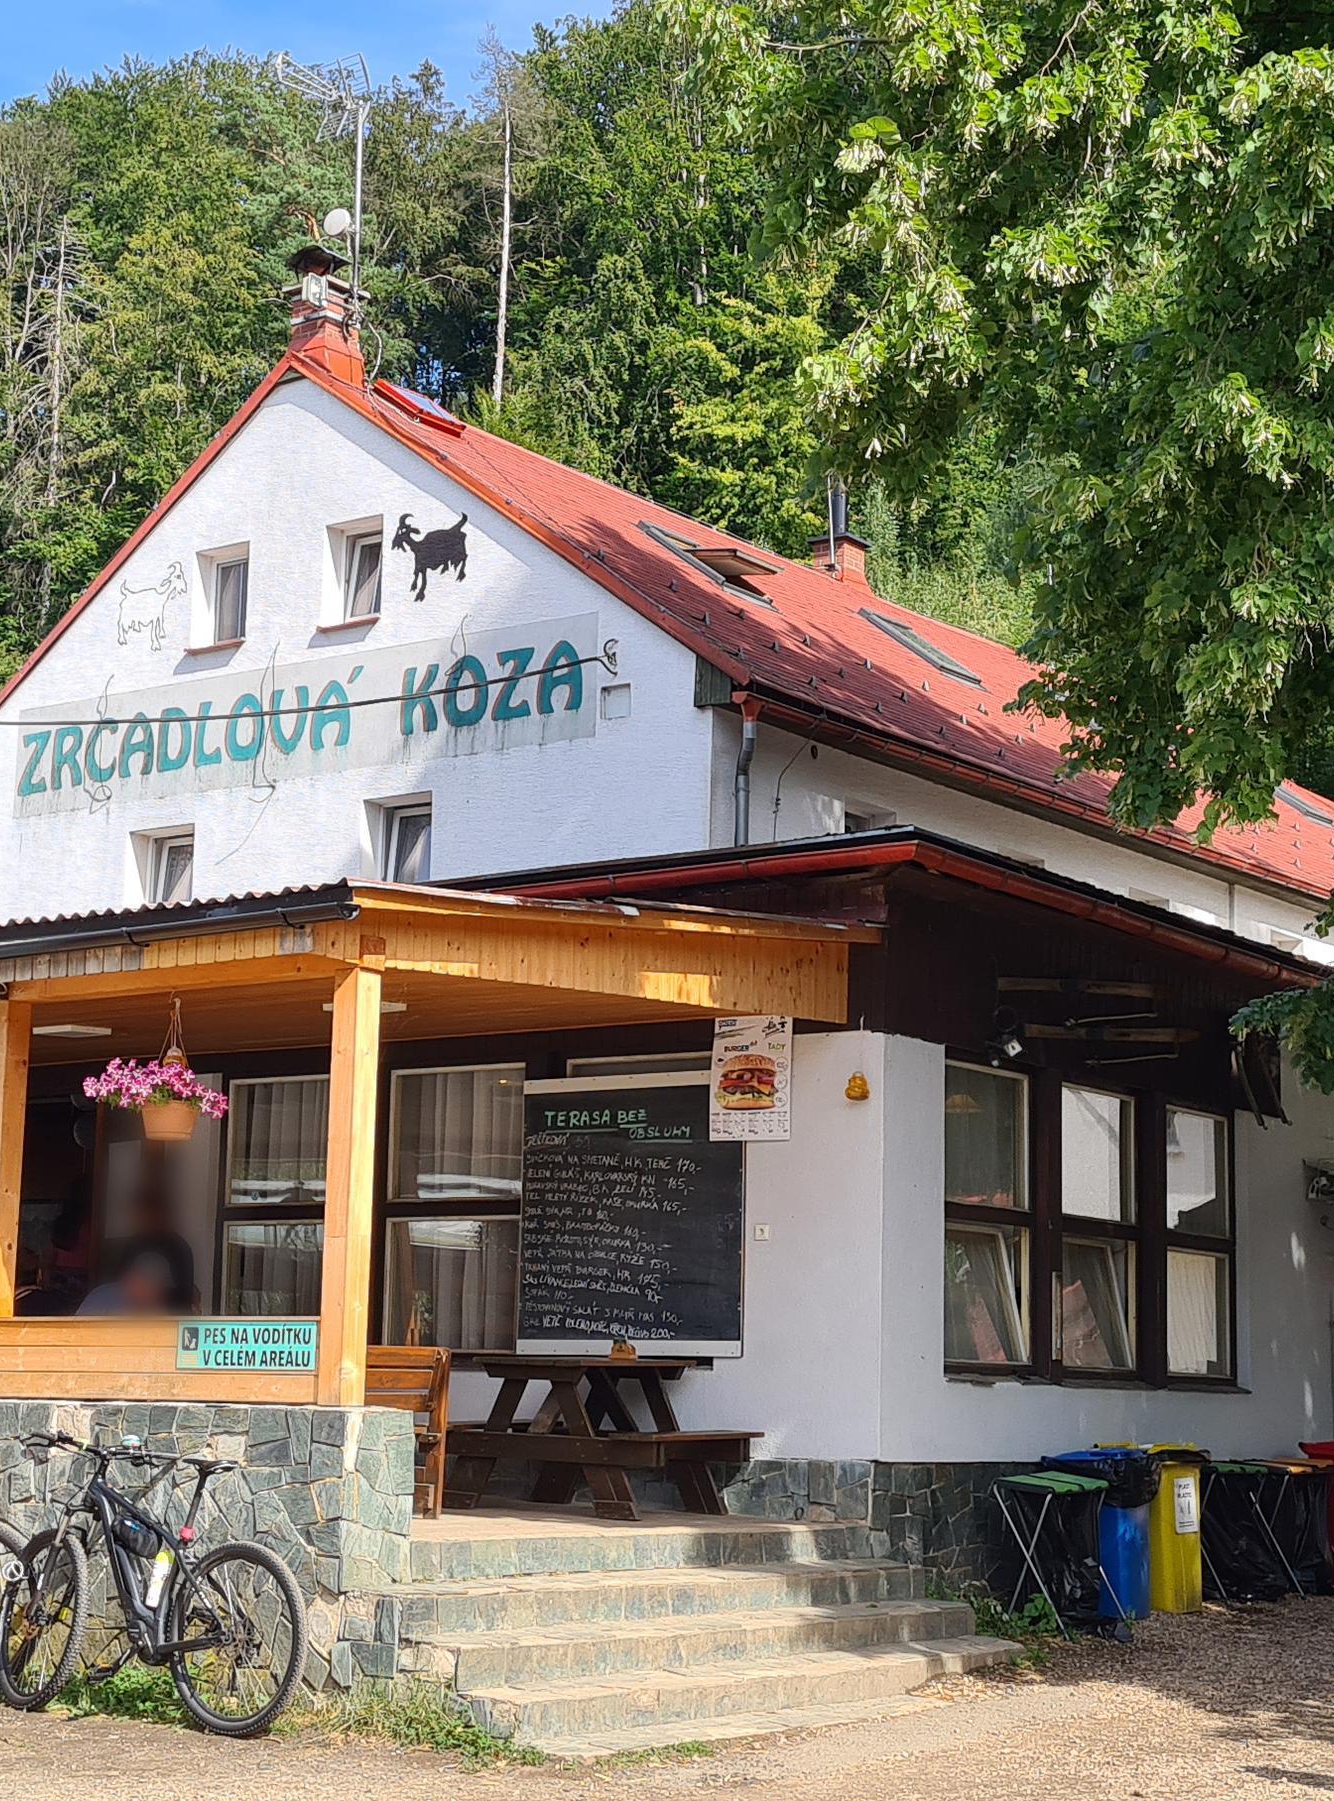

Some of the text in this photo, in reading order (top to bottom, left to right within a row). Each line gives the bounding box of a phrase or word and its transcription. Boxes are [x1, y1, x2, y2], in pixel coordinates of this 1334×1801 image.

[17, 639, 584, 797] ZRCADLOVÁ KOZA
[544, 1108, 611, 1127] TERASA
[628, 1126, 691, 1139] OBSLUHY
[203, 1323, 312, 1345] PES NA VODÍTKU
[202, 1346, 311, 1367] V CELÉM AREÁLU
